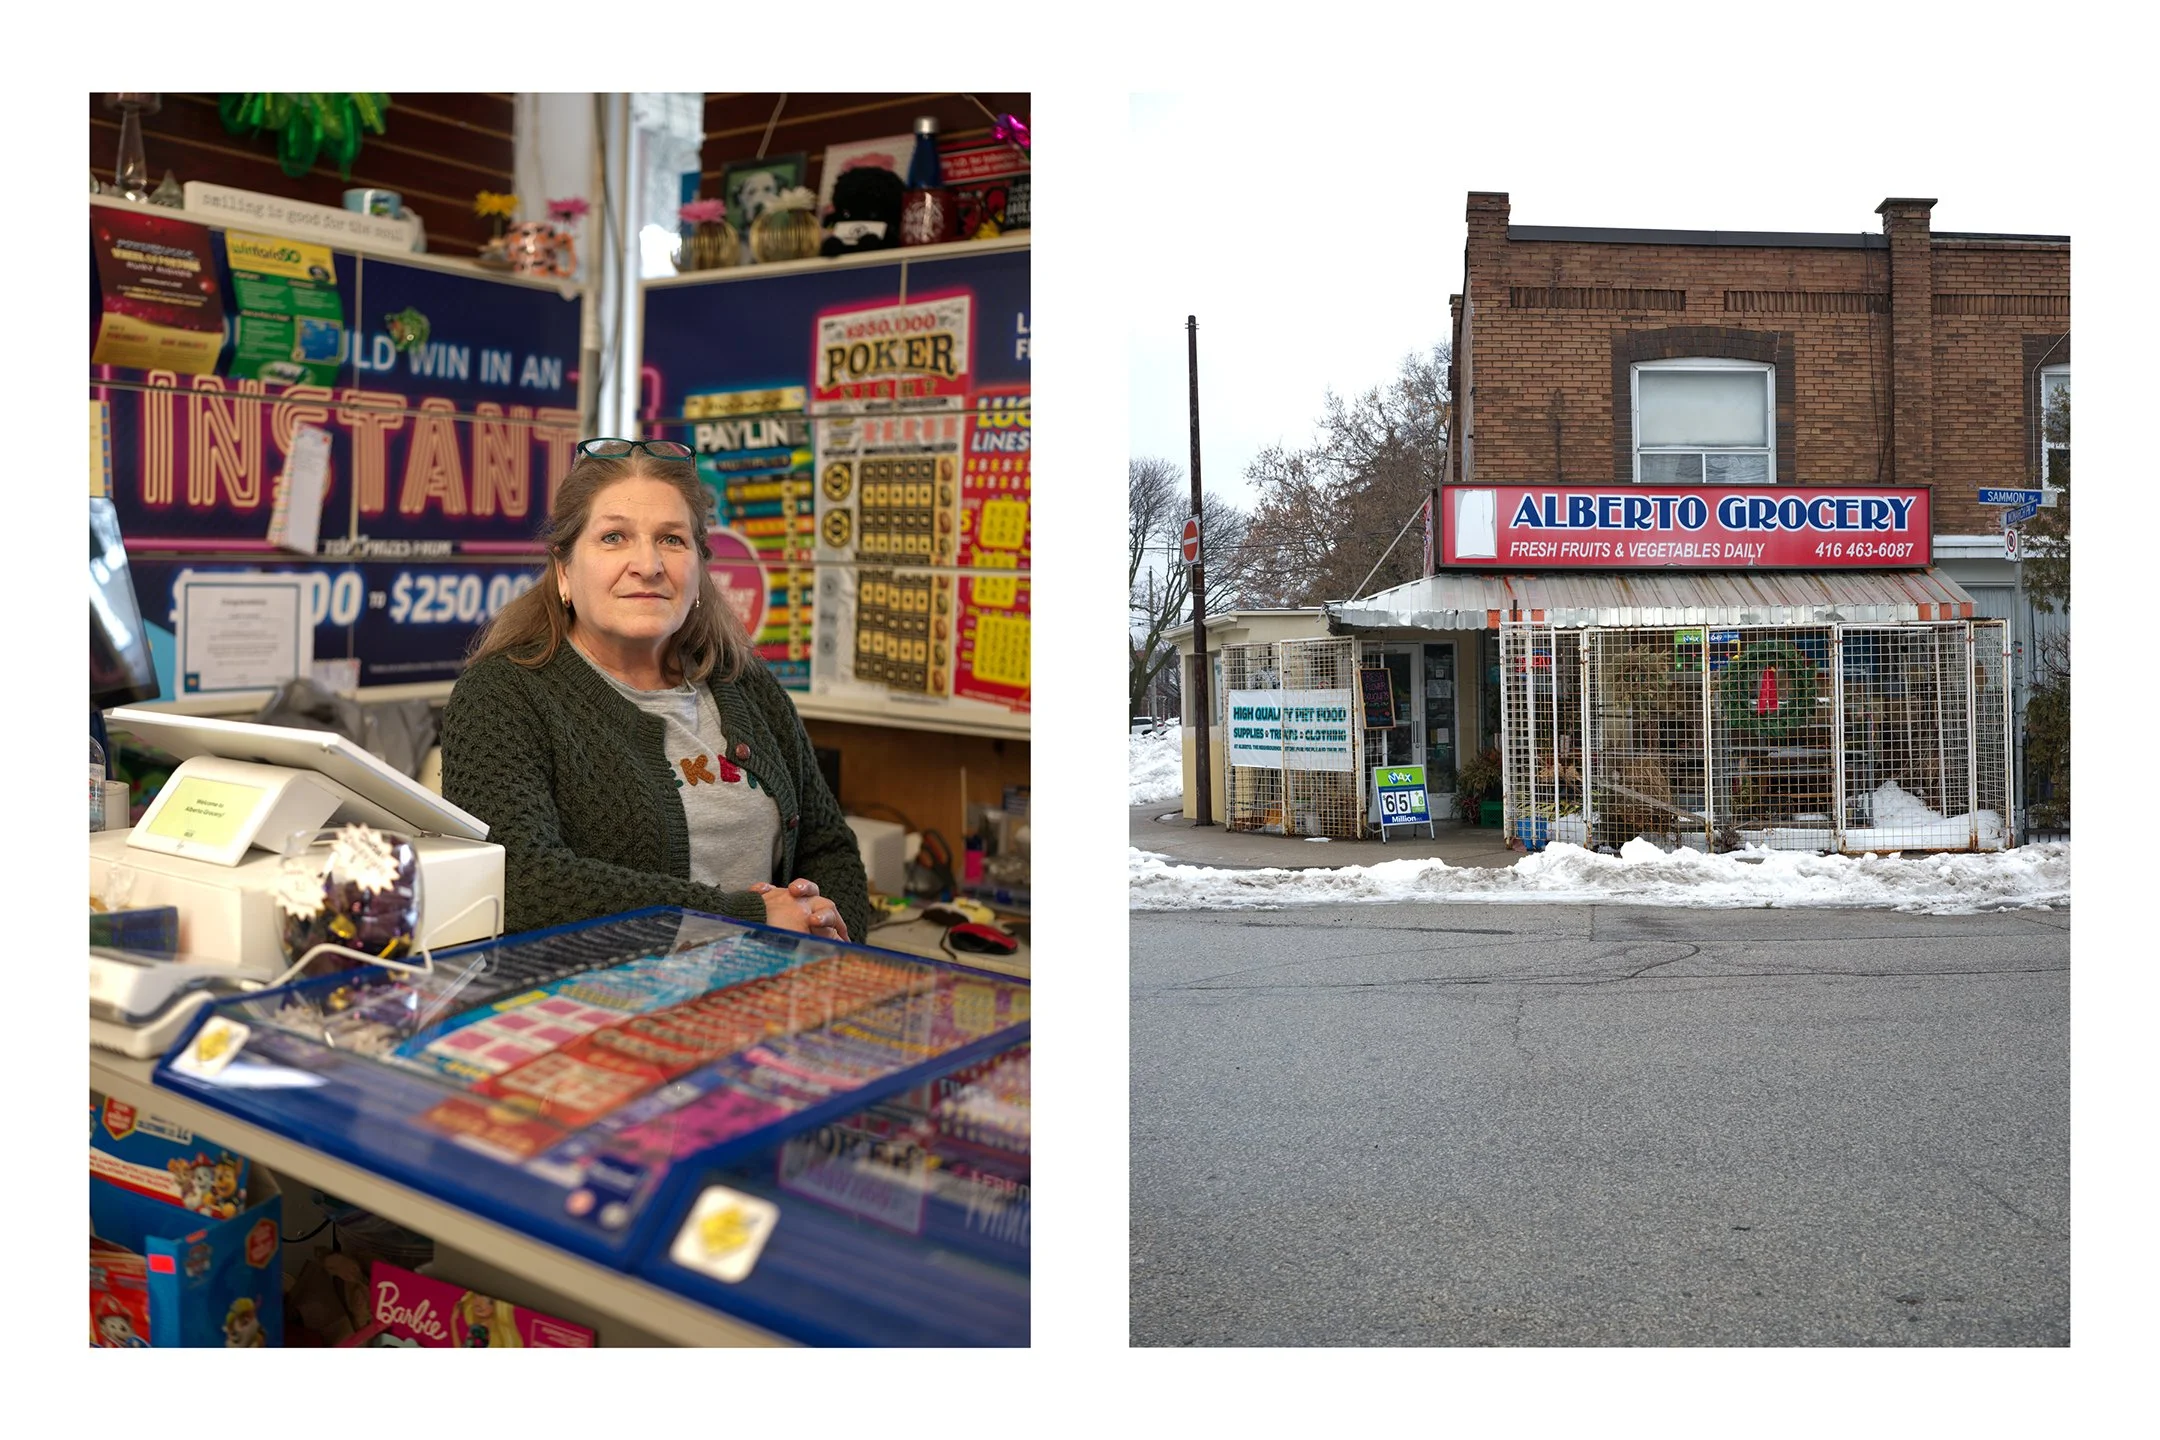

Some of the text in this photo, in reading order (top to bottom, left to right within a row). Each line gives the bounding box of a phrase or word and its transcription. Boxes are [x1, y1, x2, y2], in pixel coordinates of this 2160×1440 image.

[202, 192, 265, 217] smiling
[408, 341, 471, 381] WIN
[480, 348, 513, 385] IN
[519, 354, 562, 390] AN
[824, 331, 958, 390] POKER
[971, 430, 1030, 453] LINES
[1987, 491, 2026, 503] SAMMON
[1509, 493, 1917, 532] ALBERTO GROCERY
[1510, 541, 1914, 558] FRESH FRUITS & VEGETABLES DAILY 416 463-6087
[368, 591, 387, 609] TO
[1233, 707, 1254, 721] HIGH
[1295, 707, 1315, 722] PET
[1316, 707, 1347, 722] FOOD
[1233, 727, 1264, 739] SUPPLIES
[1305, 729, 1347, 742] CLOTHING
[1388, 771, 1412, 784] MAX
[1392, 815, 1416, 823] Million
[376, 1280, 449, 1341] Barbie
